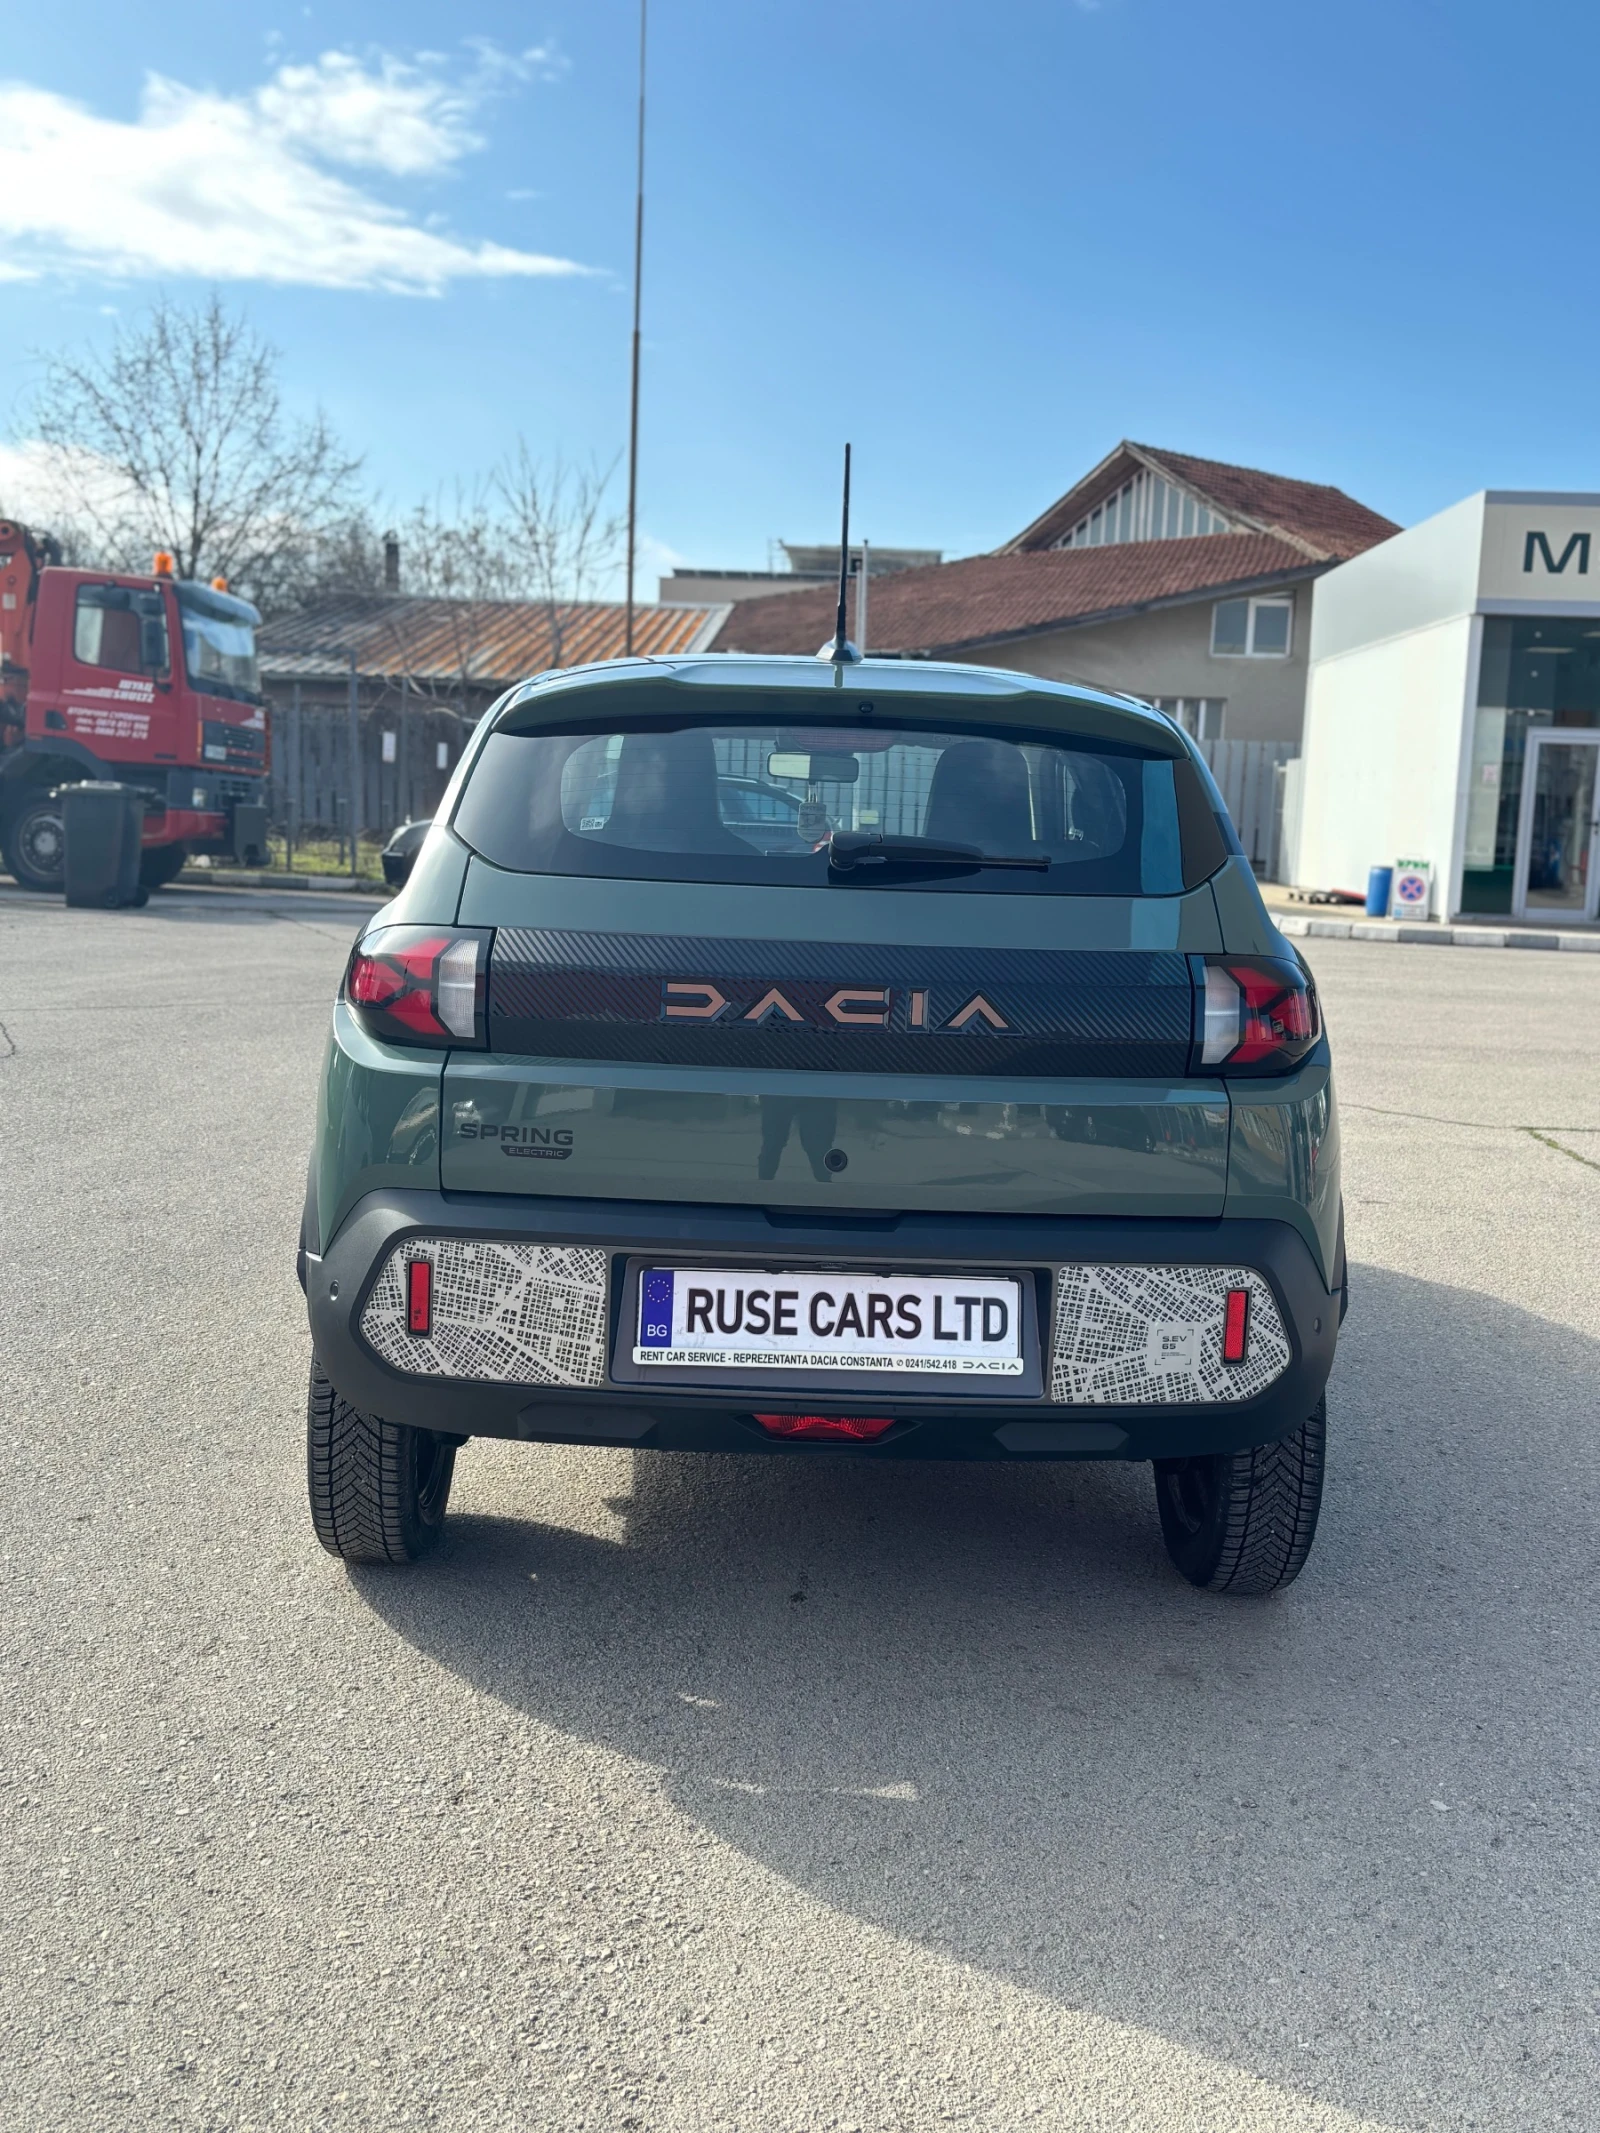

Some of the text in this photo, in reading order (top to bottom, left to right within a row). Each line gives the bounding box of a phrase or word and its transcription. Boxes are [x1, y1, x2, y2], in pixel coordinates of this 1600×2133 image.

[661, 978, 1020, 1034] DACIA
[459, 1122, 574, 1146] SPRING
[508, 1147, 564, 1158] ELECTRIC
[687, 1287, 1009, 1342] RUSE CARS LTD
[647, 1324, 668, 1337] BG
[1162, 1335, 1187, 1343] S.EV
[640, 1350, 665, 1362] RENT
[666, 1351, 687, 1362] CAR
[687, 1352, 726, 1363] SERVICE
[733, 1353, 808, 1365] REPREZENTANTA
[810, 1355, 839, 1366] DACIA
[840, 1356, 894, 1368] CONSTANTA
[905, 1359, 957, 1370] 0241/542.418
[962, 1361, 1019, 1371] DACIA
